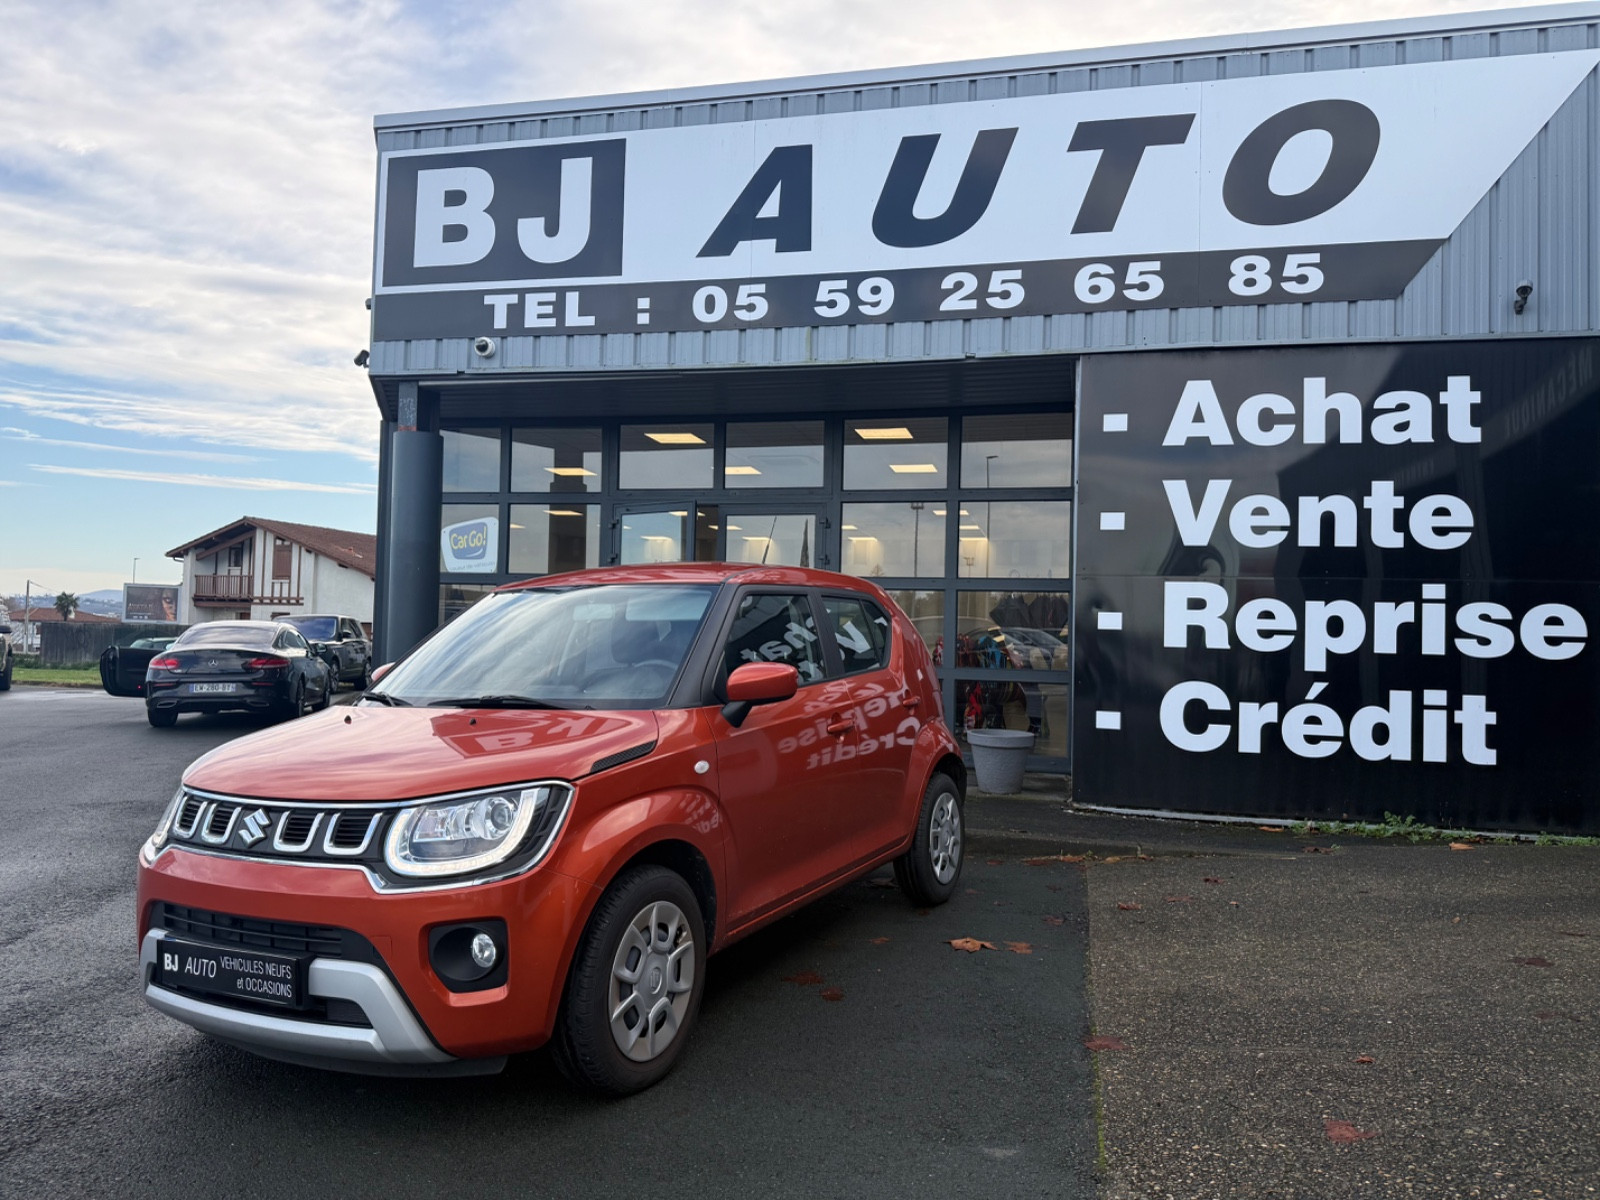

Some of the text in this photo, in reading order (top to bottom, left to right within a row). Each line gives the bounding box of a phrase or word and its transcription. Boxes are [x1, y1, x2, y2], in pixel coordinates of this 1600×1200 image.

[413, 98, 1381, 268] BJ AUTO
[483, 291, 596, 330] TEL
[692, 284, 769, 324] 05
[814, 276, 895, 318] 59
[939, 269, 1026, 312] 25
[1073, 260, 1165, 304] 65
[1228, 252, 1325, 296] 85
[1161, 375, 1482, 447] Achat
[450, 525, 487, 550] Car Go!
[1161, 478, 1475, 550] Vente
[1163, 580, 1588, 672] Reprise
[1159, 680, 1497, 766] Crédit
[164, 953, 217, 978] BJ AUTO
[220, 955, 292, 980] VEHICULES NEUFS
[236, 977, 292, 998] et OCCASIONS
